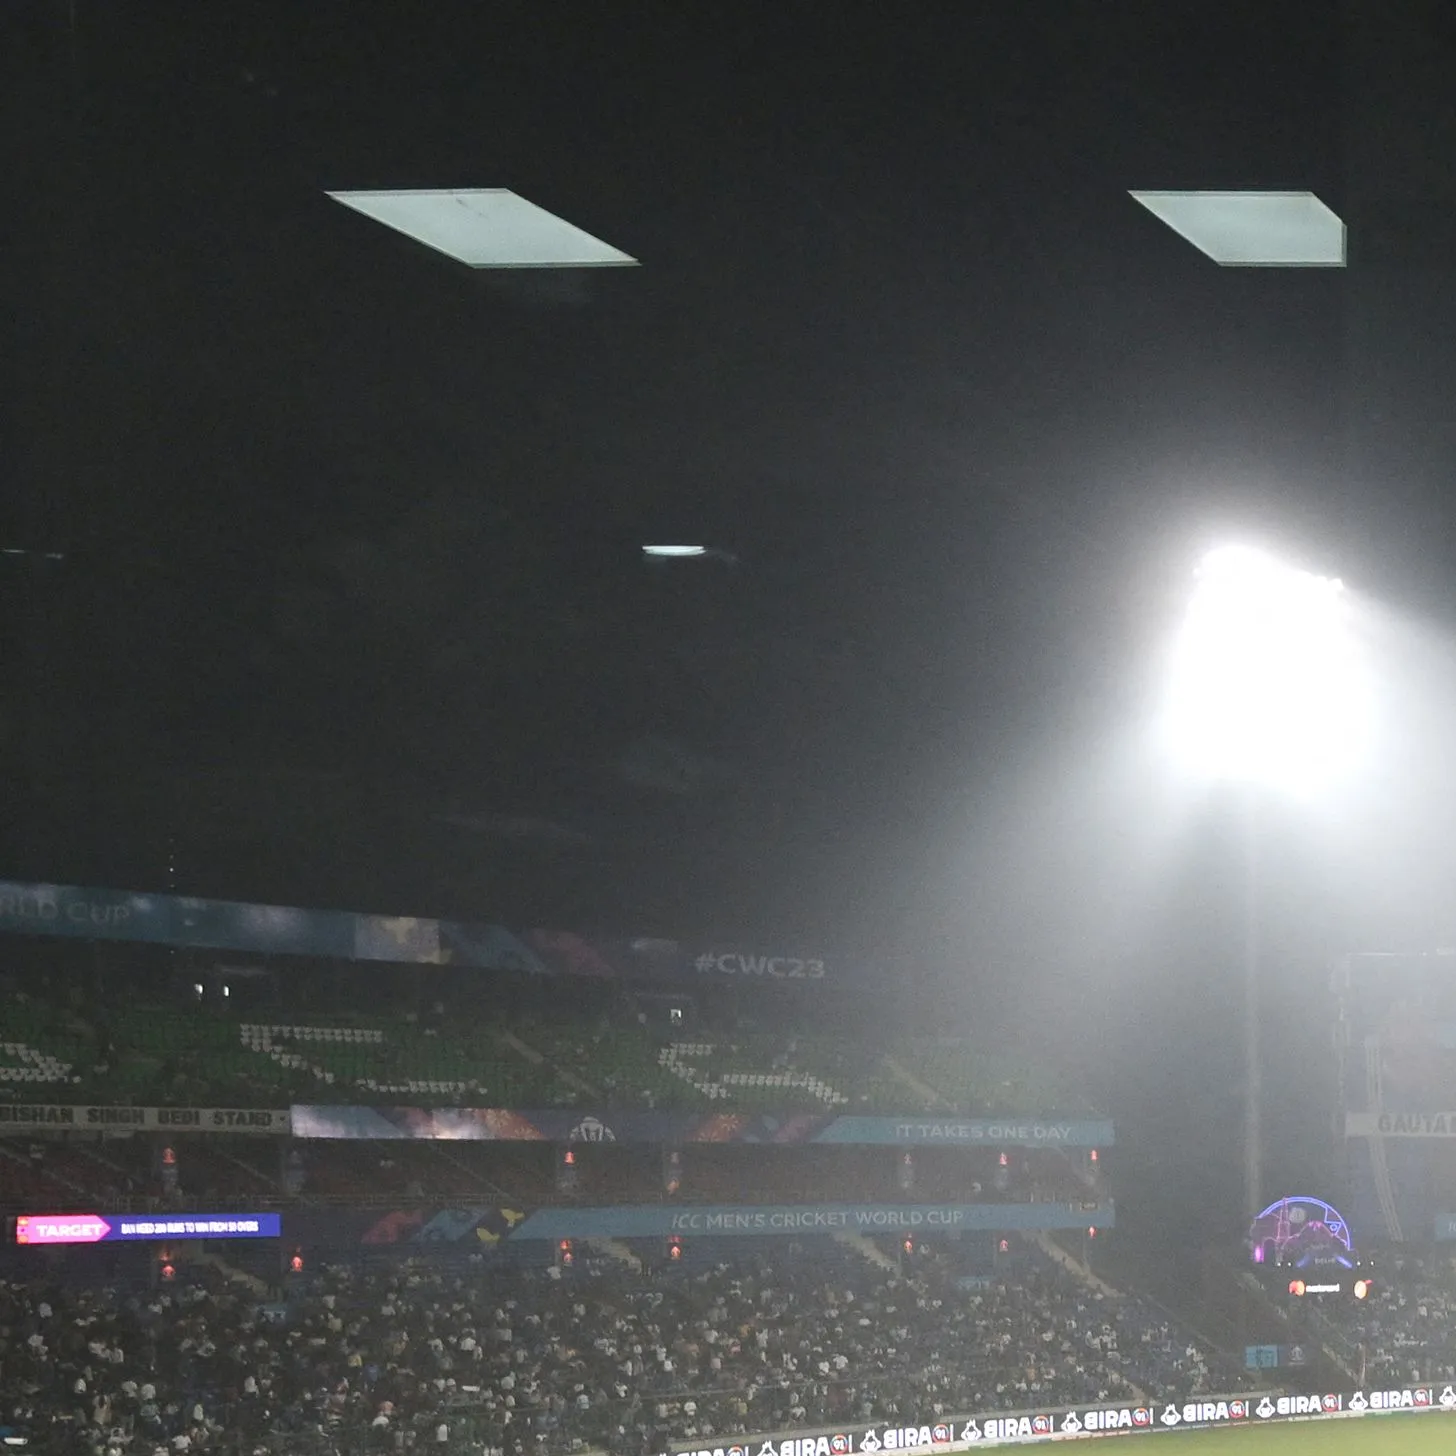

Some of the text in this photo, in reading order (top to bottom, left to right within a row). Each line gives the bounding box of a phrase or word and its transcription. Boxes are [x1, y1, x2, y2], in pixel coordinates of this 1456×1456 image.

[695, 952, 825, 978] #CWC23
[87, 1108, 144, 1123] SINGH
[158, 1110, 199, 1124] BEDI
[214, 1111, 272, 1125] STAND
[917, 1125, 983, 1138] TAKES
[988, 1126, 1028, 1139] ONE
[1034, 1126, 1071, 1139] DAY
[672, 1211, 963, 1228] ICC MEN'S CRICKET WORLD CUP
[36, 1223, 103, 1238] TARGET
[1277, 1397, 1323, 1413] BIRA
[1370, 1391, 1414, 1407] BIRA
[1084, 1410, 1132, 1430] BIRA
[1182, 1402, 1228, 1421] BIRA
[884, 1425, 931, 1448] BIRA
[984, 1418, 1031, 1438] BIRA
